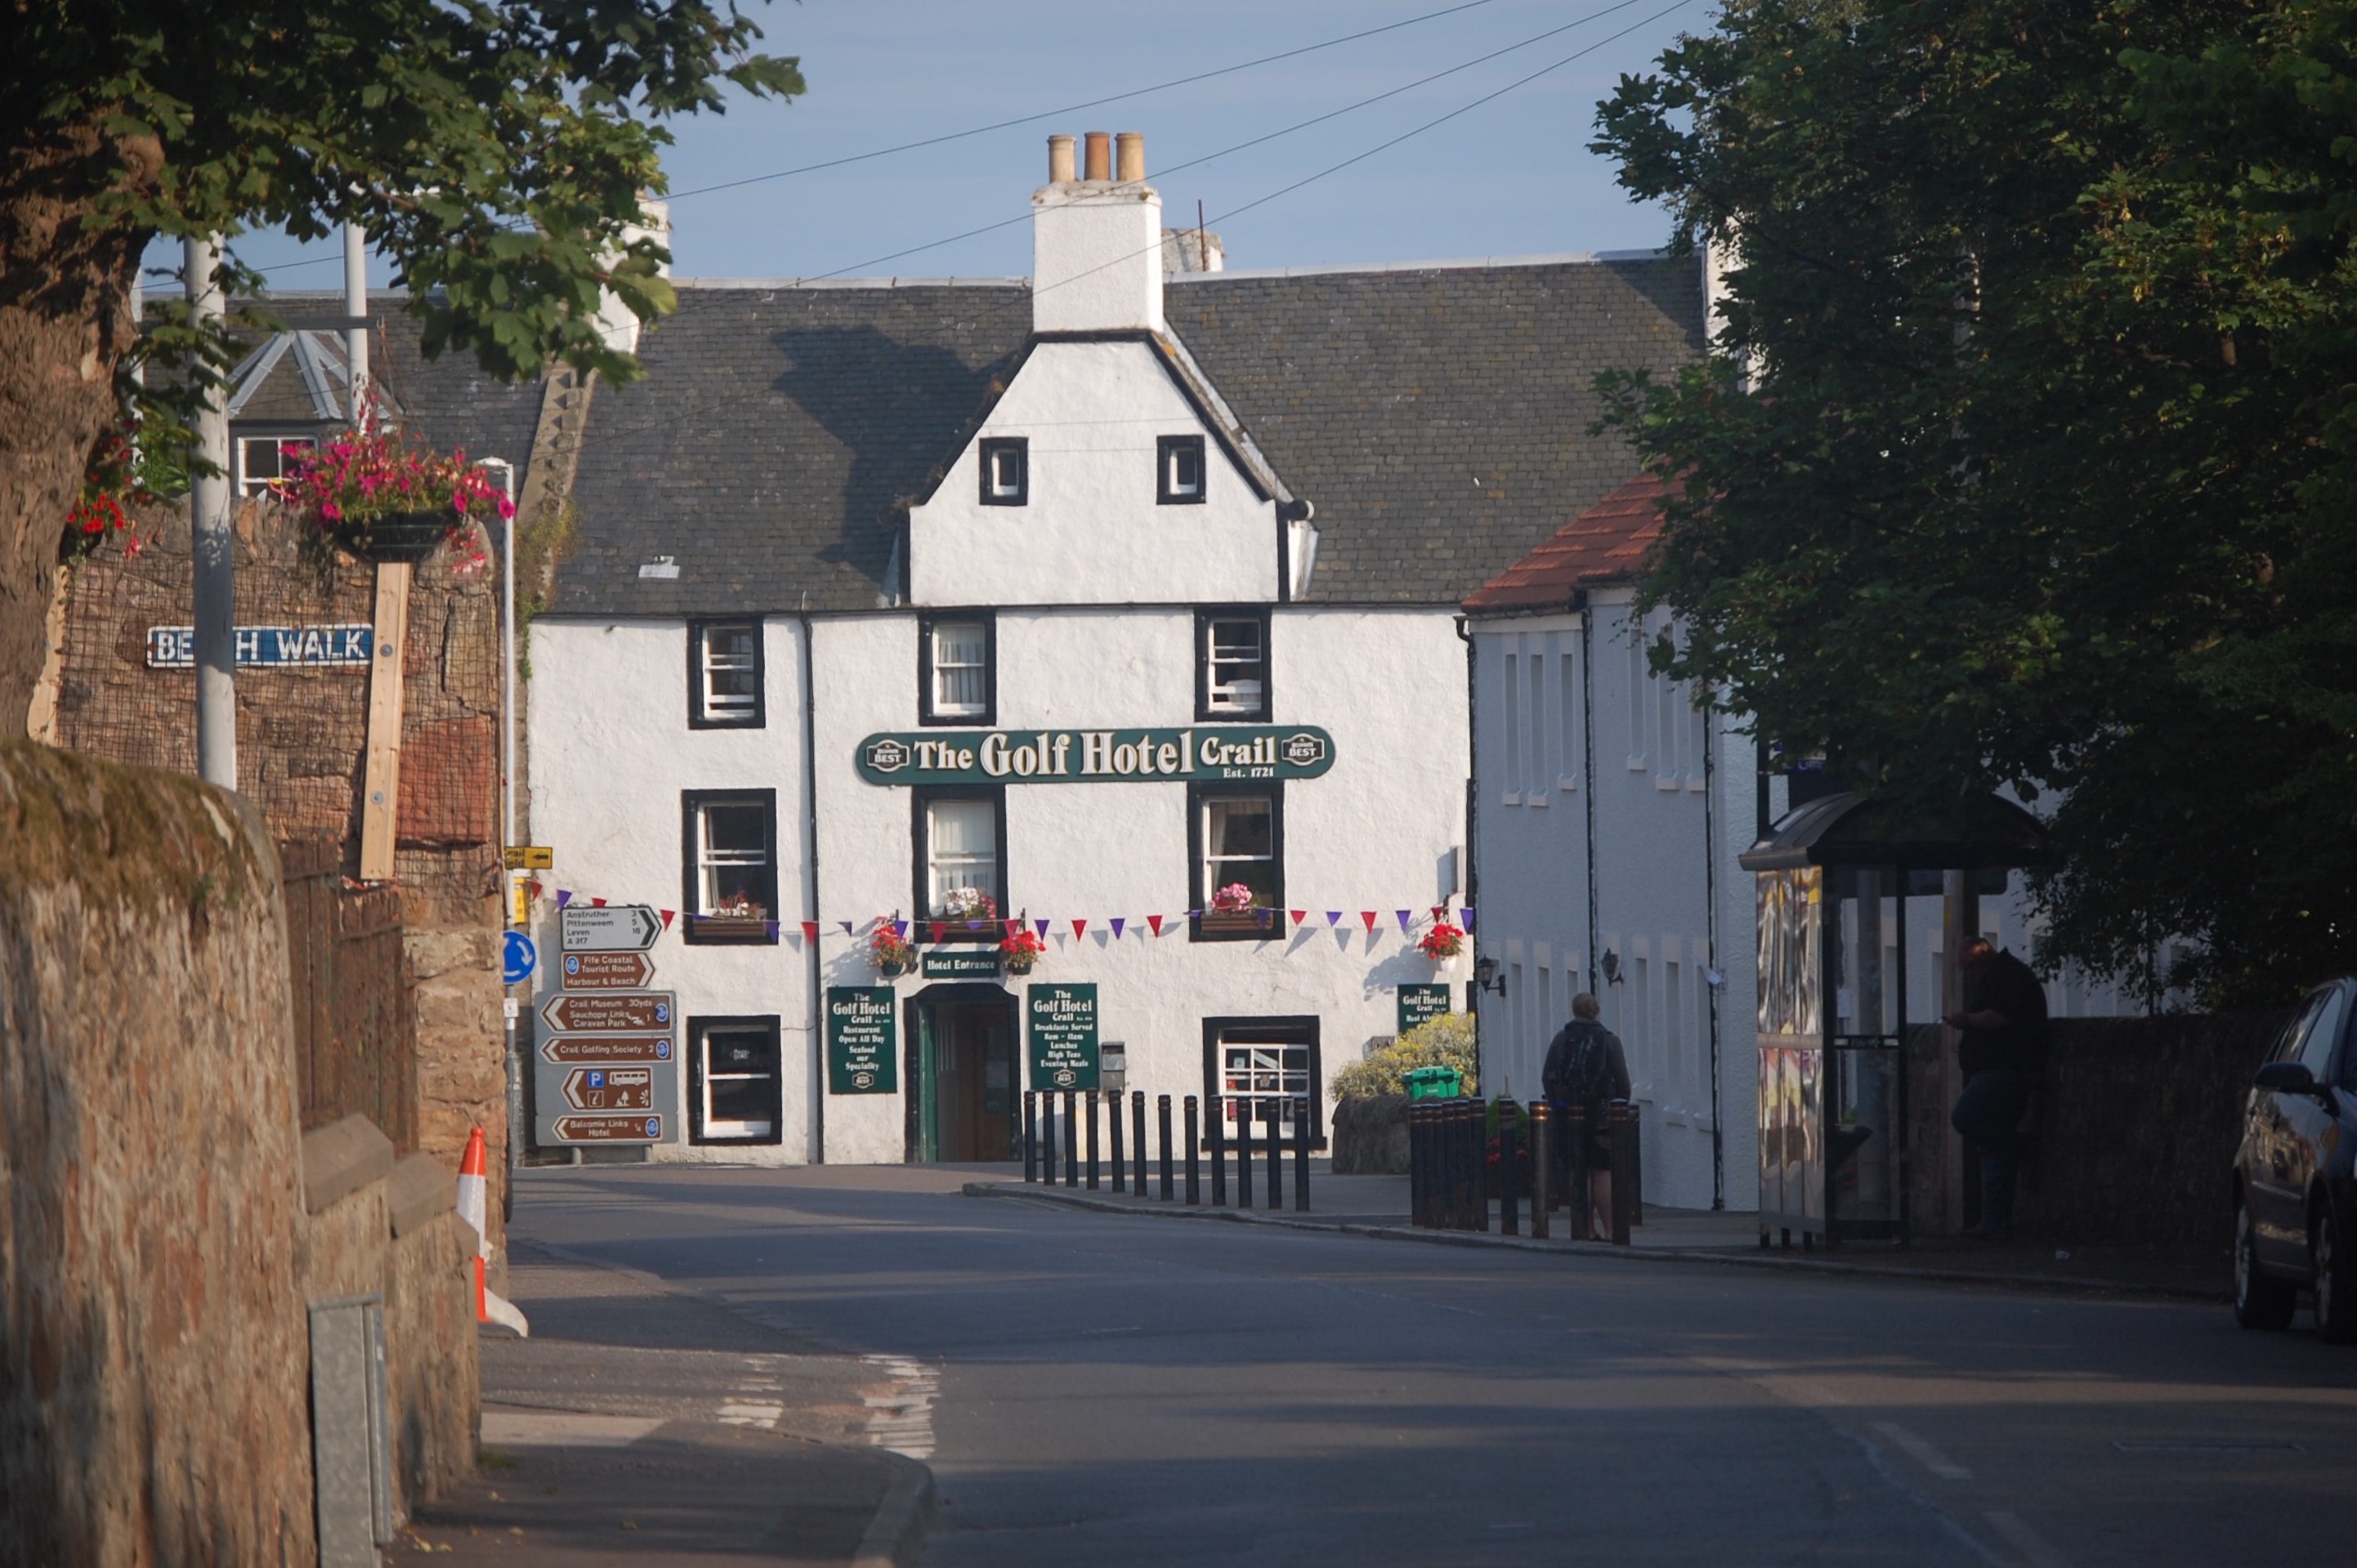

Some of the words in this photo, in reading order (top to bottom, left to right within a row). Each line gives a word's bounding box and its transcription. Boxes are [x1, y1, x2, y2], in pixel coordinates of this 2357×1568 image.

[157, 632, 259, 660] BEH
[276, 630, 366, 660] WALK
[914, 739, 973, 770] The
[980, 731, 1071, 776] Golf
[1080, 730, 1196, 775] Hotel
[1200, 735, 1277, 766] Crail
[1289, 748, 1317, 757] BEST
[874, 753, 901, 763] BEST
[1223, 768, 1246, 778] Est.
[1250, 767, 1274, 778] 1721
[927, 959, 951, 971] Hotel
[955, 959, 995, 970] Entrance
[853, 993, 870, 1002] The
[1054, 990, 1071, 998] The
[628, 998, 652, 1008] 30yds
[1402, 995, 1422, 1005] Golf
[1423, 995, 1447, 1005] Hotel
[833, 1002, 857, 1015] Golf
[860, 1002, 890, 1015] Hotel
[1034, 999, 1059, 1012] Golf
[1061, 998, 1092, 1012] Hotel
[570, 1011, 606, 1020] Sauchope
[852, 1015, 872, 1024] Crail
[1053, 1013, 1074, 1021] Crail
[843, 1025, 880, 1034] Restaurant
[1035, 1023, 1069, 1031] Breakfasts
[1071, 1023, 1093, 1031] Served
[839, 1034, 856, 1044] Open
[872, 1034, 884, 1044] Day
[1051, 1041, 1077, 1049] Lunches
[582, 1046, 610, 1054] Golfing
[613, 1046, 642, 1054] Society
[1048, 1051, 1064, 1060] High
[1040, 1059, 1067, 1069] Evening
